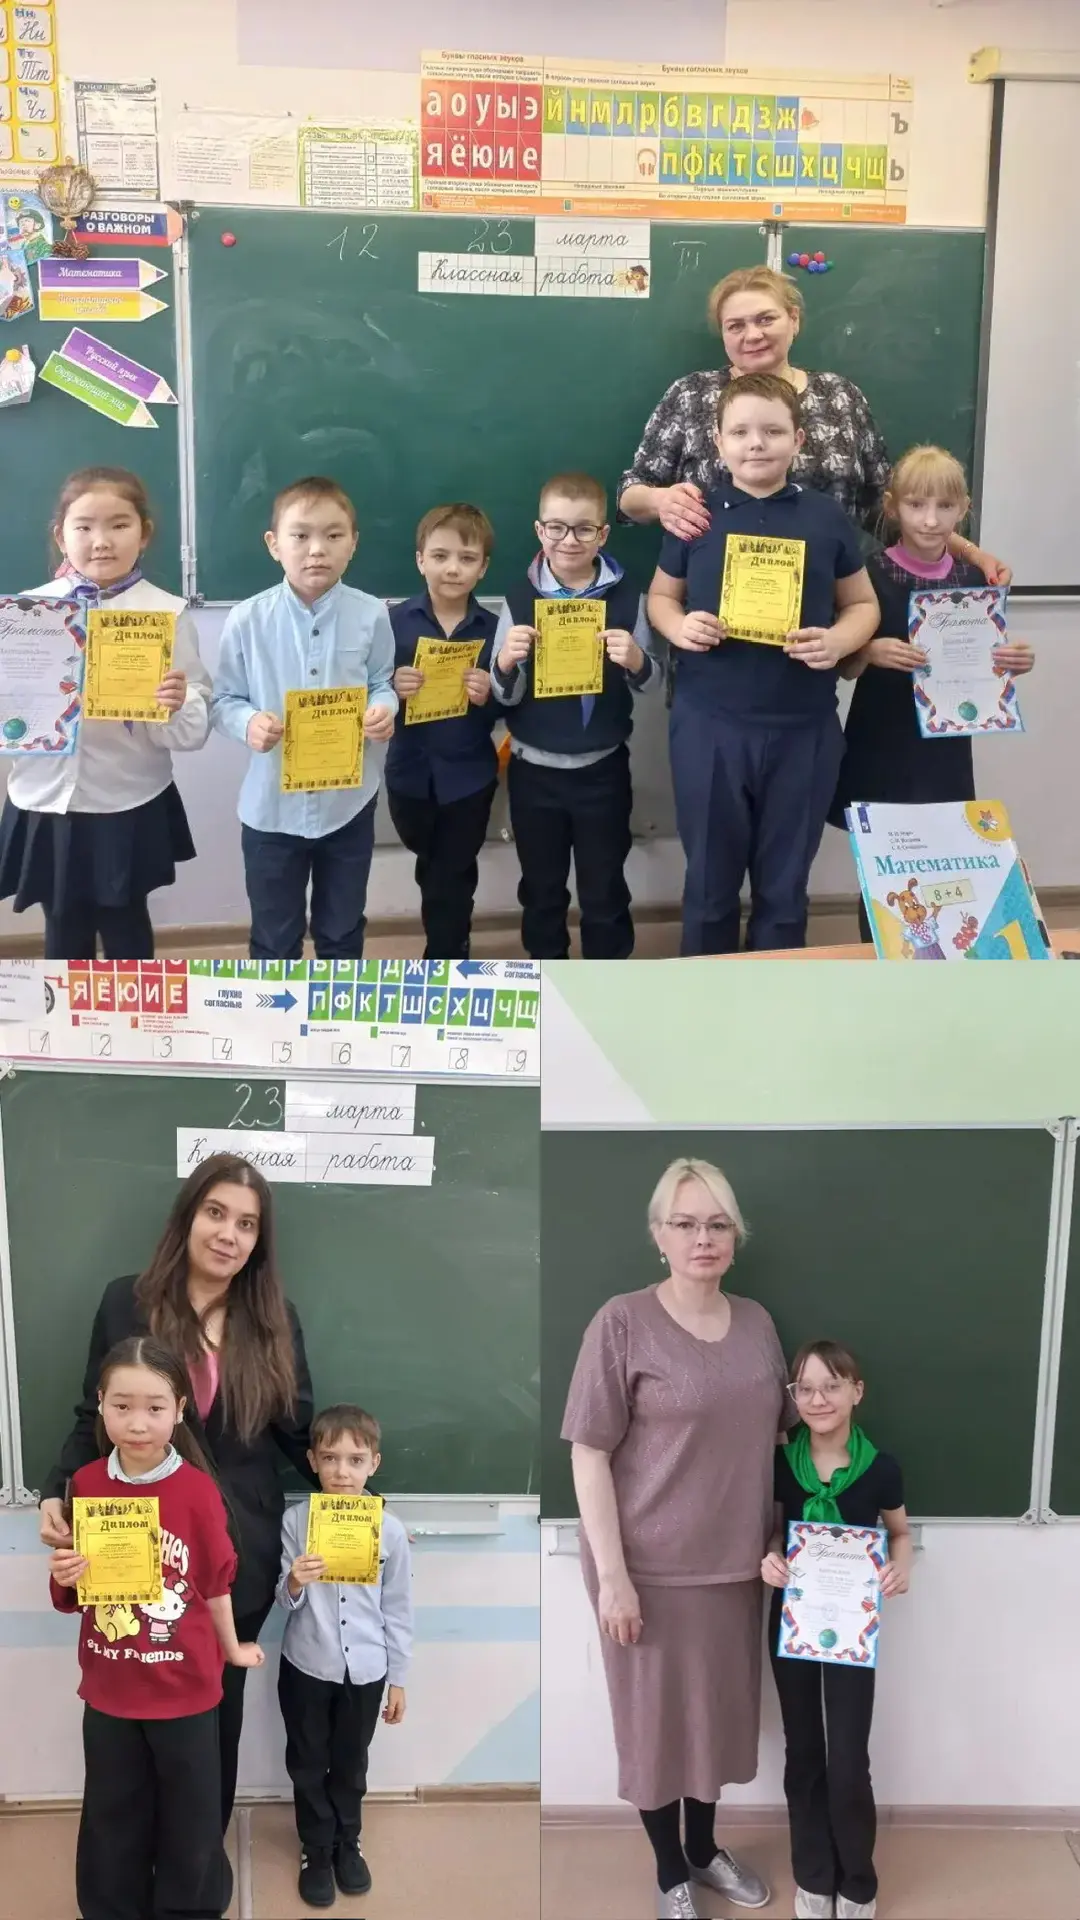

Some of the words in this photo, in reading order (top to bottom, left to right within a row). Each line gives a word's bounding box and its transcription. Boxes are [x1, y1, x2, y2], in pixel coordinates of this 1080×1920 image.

[441, 51, 465, 60] Буквы
[467, 53, 497, 61] гласных
[500, 54, 524, 64] звуков
[662, 64, 684, 73] Буквы
[686, 65, 724, 73] согласных
[725, 67, 749, 75] звуков
[426, 91, 441, 117] а
[451, 92, 466, 117] о
[476, 93, 491, 127] у
[497, 95, 517, 119] ы
[524, 96, 538, 121] э
[547, 89, 563, 123] й
[570, 98, 586, 123] н
[591, 98, 611, 125] м
[616, 100, 633, 126] л
[640, 100, 655, 133] р
[663, 96, 679, 128] б
[687, 104, 702, 128] в
[711, 104, 724, 128] г
[732, 105, 751, 134] д
[757, 105, 772, 130] з
[776, 107, 796, 131] ж
[427, 142, 442, 167] я
[451, 135, 466, 167] ё
[472, 144, 493, 169] ю
[499, 145, 515, 170] и
[523, 146, 538, 170] е
[662, 152, 677, 175] п
[683, 144, 703, 184] ф
[708, 152, 723, 177] к
[732, 153, 747, 177] т
[756, 154, 768, 178] с
[775, 155, 795, 178] ш
[801, 155, 817, 179] х
[822, 155, 838, 185] ц
[846, 156, 861, 179] ч
[866, 157, 885, 187] щ
[83, 211, 155, 223] РАЗГОВОРЫ
[86, 222, 96, 232] О
[98, 223, 151, 235] ВАЖНОМ
[467, 217, 513, 254] 23
[326, 224, 379, 260] 12
[556, 232, 629, 254] марта
[58, 265, 123, 279] Математика
[431, 258, 523, 283] Классная
[539, 262, 617, 292] работа
[85, 345, 119, 371] Русский
[117, 367, 138, 382] язык
[751, 555, 795, 567] Диплом
[559, 616, 597, 626] Диплом
[114, 630, 164, 643] Диплом
[311, 706, 357, 720] Диплом
[874, 853, 1001, 877] Математика
[934, 888, 942, 901] 8
[955, 886, 963, 898] 4
[993, 919, 1029, 960] 1
[406, 960, 424, 975] Ж
[73, 981, 88, 1001] Я
[98, 978, 111, 1002] Ё
[118, 982, 138, 1003] Ю
[145, 983, 160, 1004] И
[170, 984, 183, 1004] Е
[312, 991, 325, 1010] П
[334, 993, 351, 1010] Ф
[360, 993, 372, 1012] К
[385, 994, 396, 1012] Т
[403, 995, 422, 1014] Ш
[428, 996, 443, 1015] С
[451, 997, 465, 1016] Х
[474, 998, 489, 1020] Ц
[499, 999, 512, 1017] Ч
[518, 1000, 536, 1023] Щ
[40, 1031, 49, 1052] 1
[99, 1034, 112, 1056] 2
[160, 1036, 173, 1058] 3
[220, 1038, 232, 1060] 4
[280, 1041, 292, 1063] 5
[339, 1043, 352, 1065] 6
[399, 1045, 412, 1067] 7
[455, 1048, 469, 1069] 8
[513, 1050, 527, 1072] 9
[228, 1083, 284, 1128] 23
[327, 1104, 403, 1128] марта
[323, 1143, 416, 1180] работа
[100, 1519, 149, 1532] Диплом
[331, 1513, 372, 1523] Диплом
